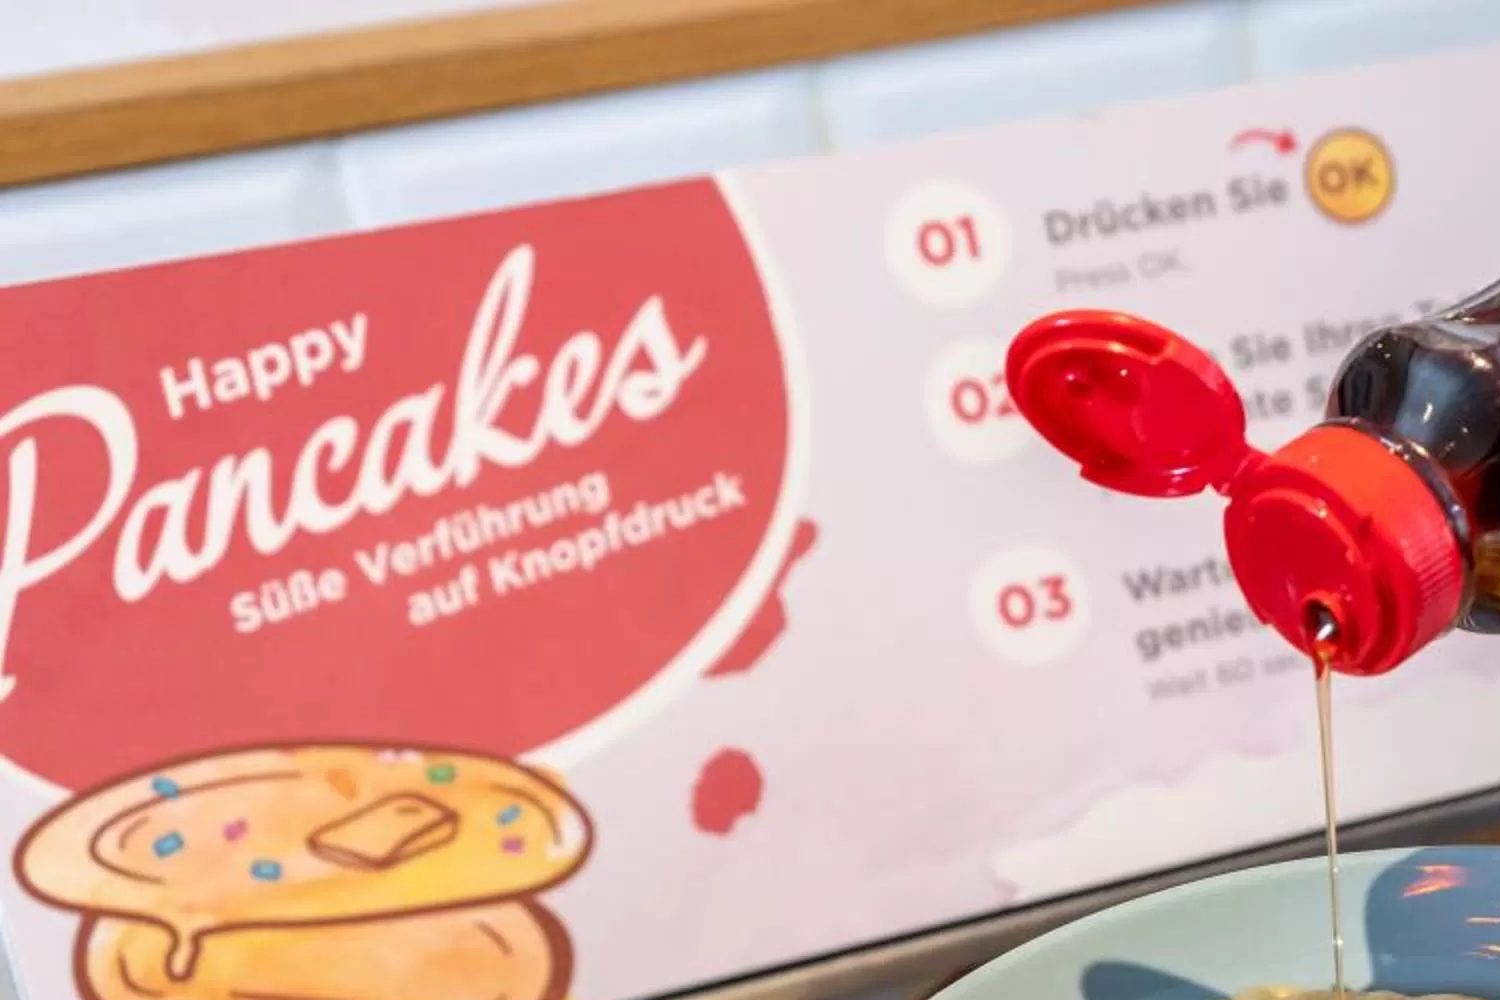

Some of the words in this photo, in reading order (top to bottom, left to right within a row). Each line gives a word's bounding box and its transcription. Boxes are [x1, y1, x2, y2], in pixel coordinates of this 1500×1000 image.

[917, 215, 981, 268] 01
[1043, 188, 1216, 247] Drücken
[1226, 171, 1290, 213] Sie
[1317, 157, 1380, 197] OK
[161, 314, 368, 419] Happy
[1228, 332, 1292, 370] Sie
[0, 244, 708, 703] Pancakes
[229, 568, 347, 634] Süße
[355, 471, 610, 585] Verführung
[407, 567, 479, 626] auf
[488, 471, 747, 594] Knopfdruck
[997, 573, 1072, 629] 03
